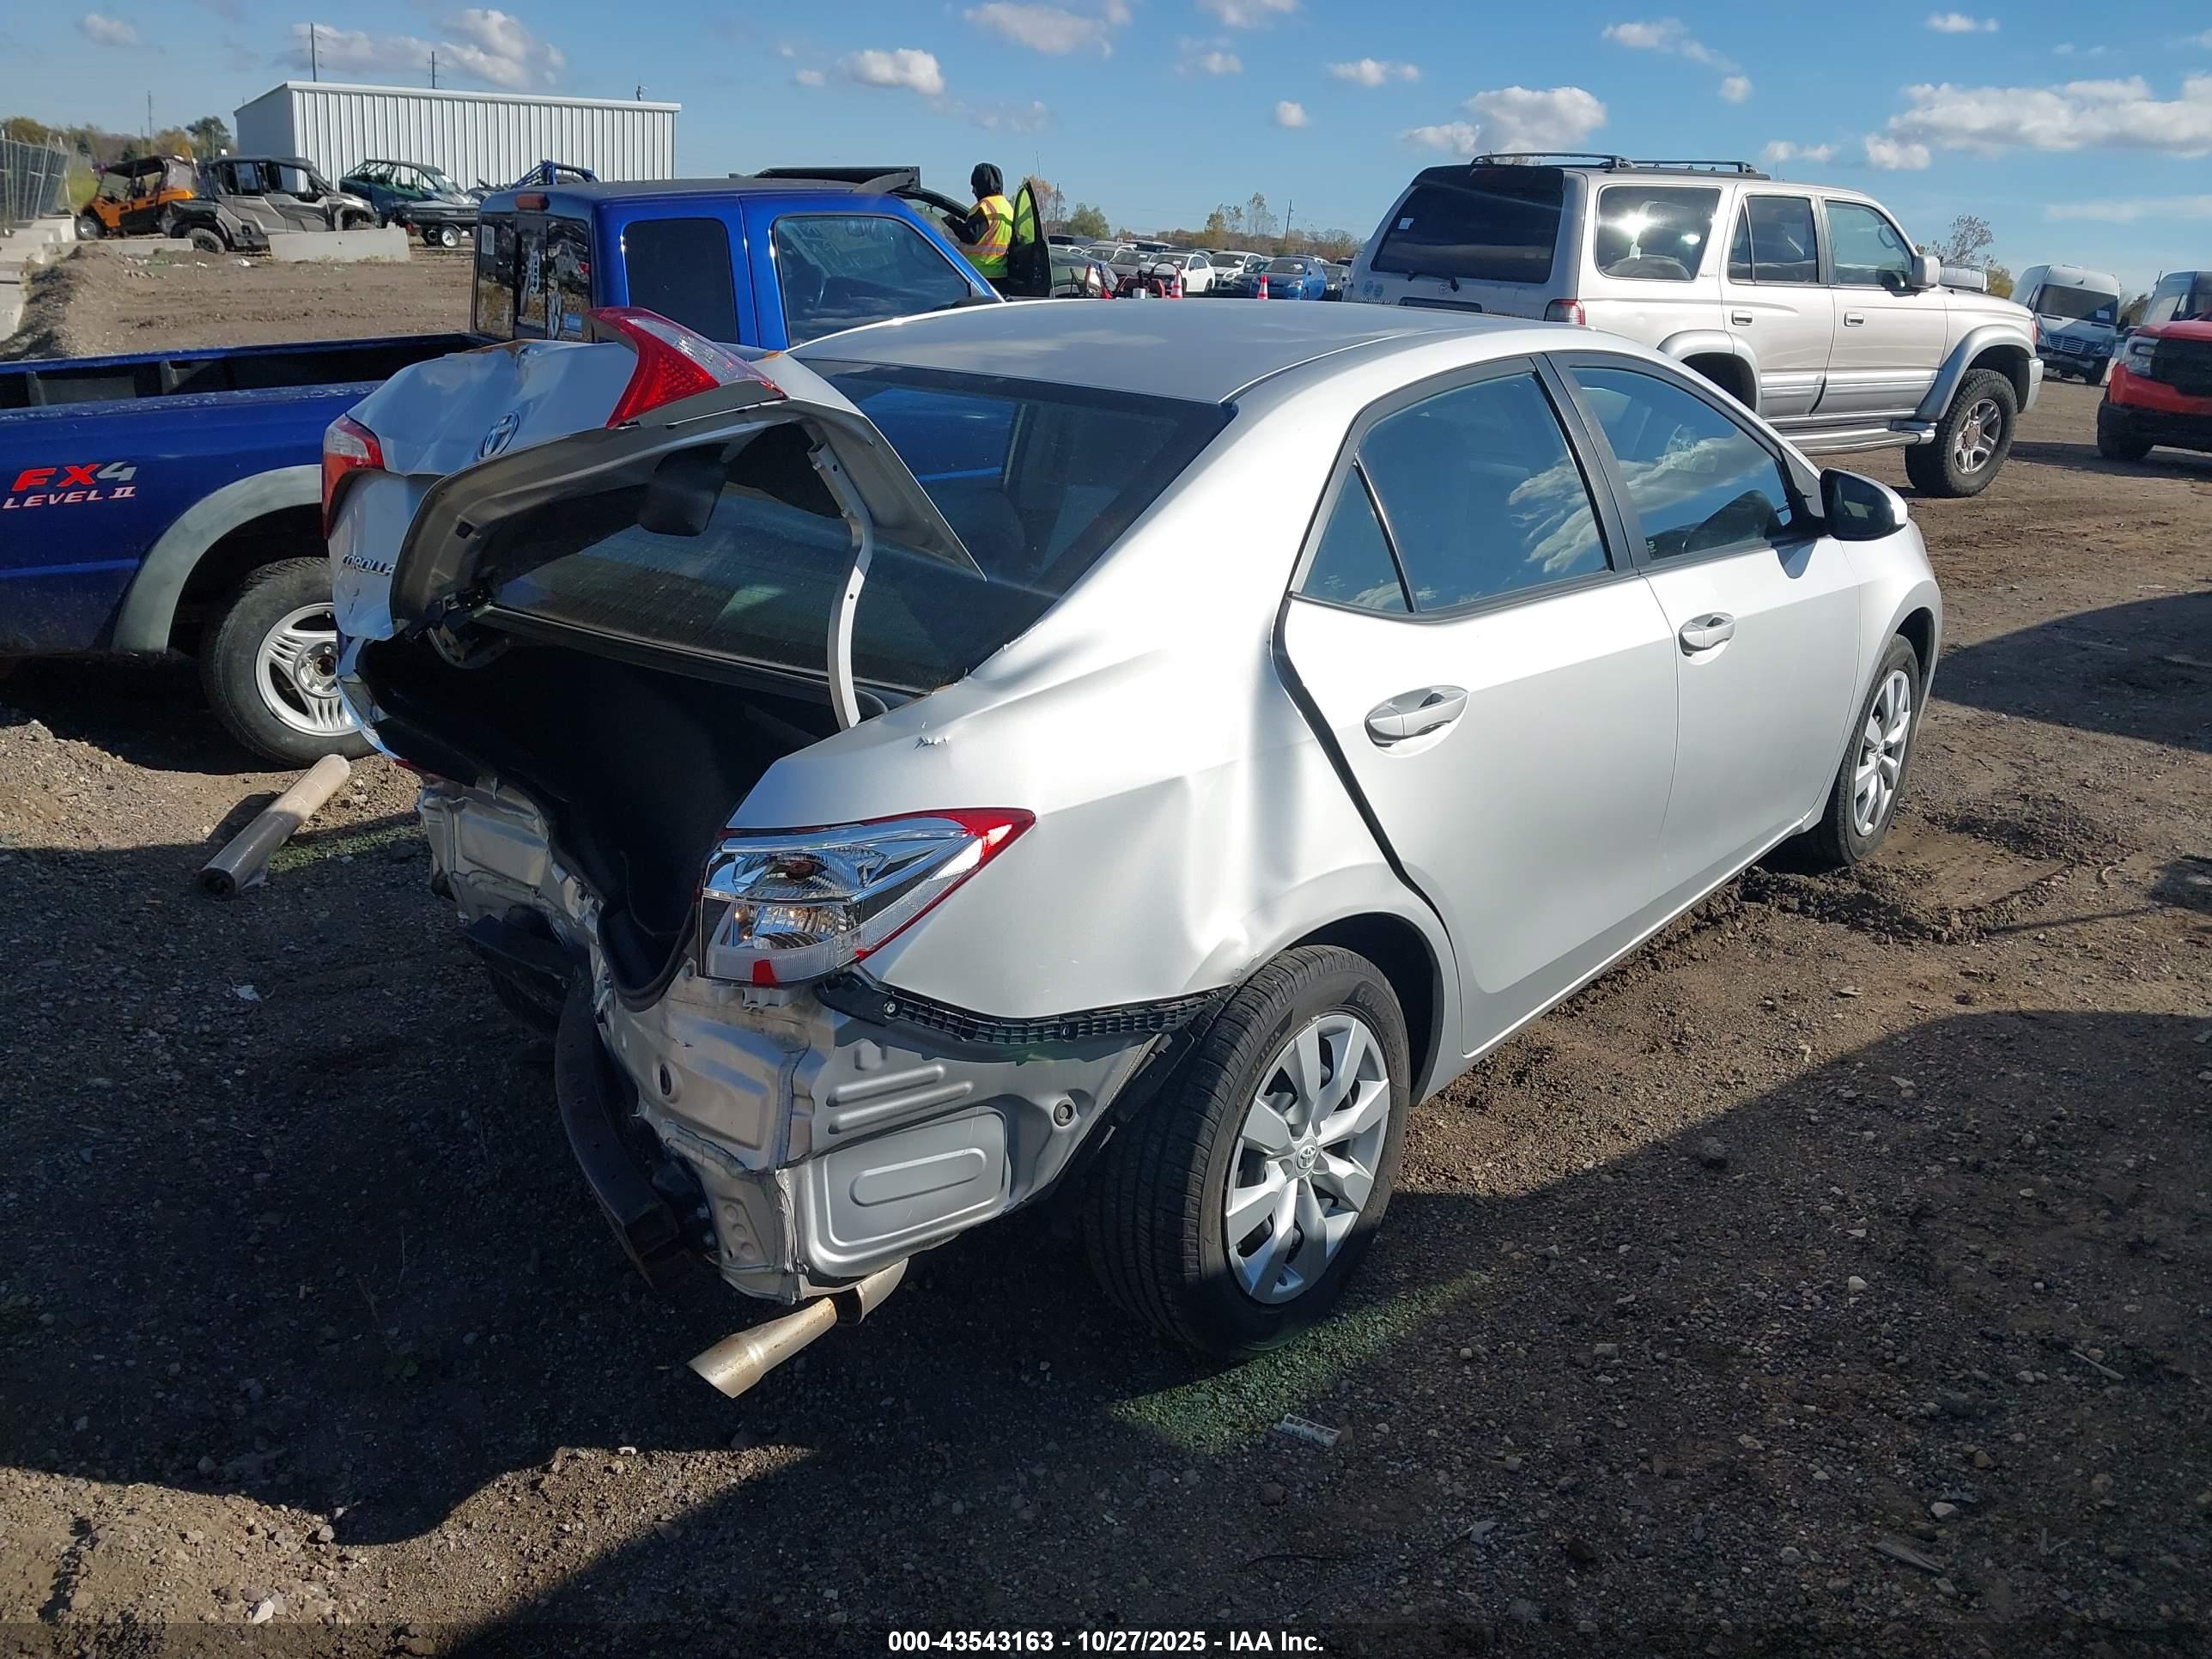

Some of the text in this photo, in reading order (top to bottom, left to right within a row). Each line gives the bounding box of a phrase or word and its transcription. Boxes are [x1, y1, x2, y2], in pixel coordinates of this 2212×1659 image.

[12, 461, 137, 492] FX4
[3, 486, 137, 509] LEVEL II
